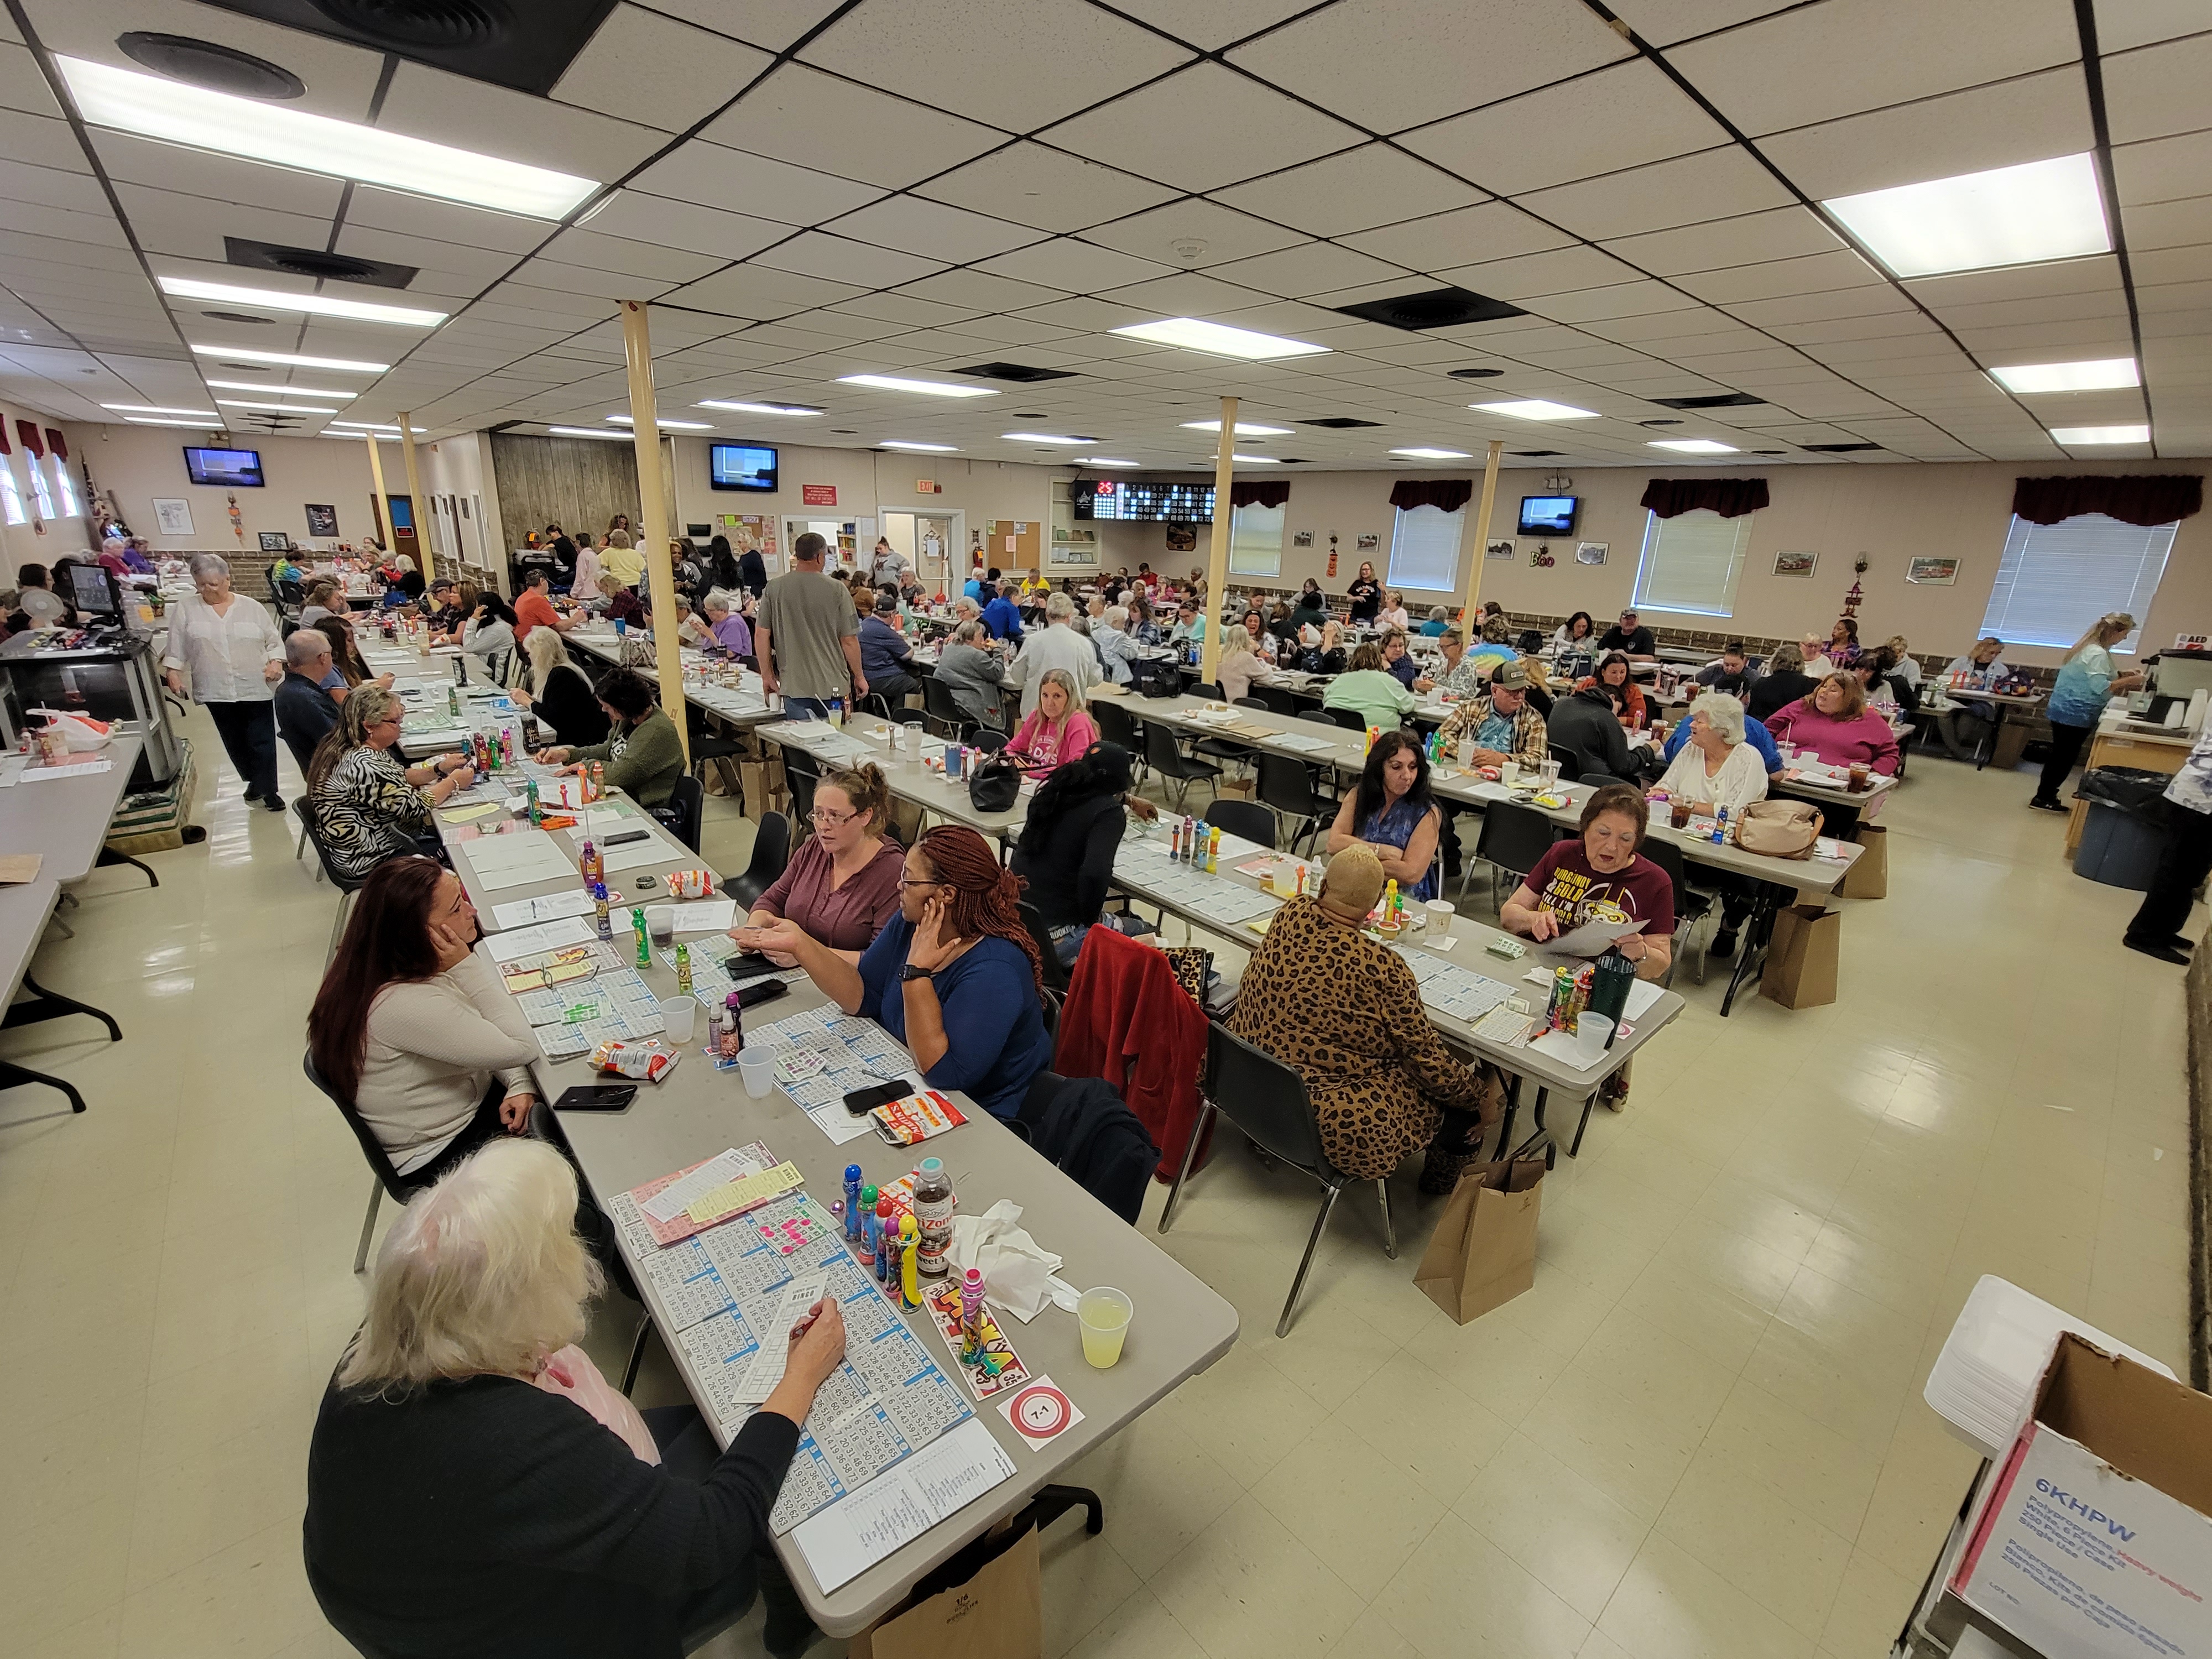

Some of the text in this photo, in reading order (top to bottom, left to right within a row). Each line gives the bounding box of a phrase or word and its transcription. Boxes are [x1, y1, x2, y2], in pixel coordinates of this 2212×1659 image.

[920, 481, 932, 491] EXIT
[1098, 481, 1113, 494] 25
[1546, 878, 1584, 902] & GOLD
[1553, 867, 1592, 890] BURGUNDY
[1542, 891, 1557, 906] TILL
[1558, 899, 1574, 912] I'M
[891, 1104, 921, 1135] MARTIN'S
[917, 1212, 953, 1230] riZon
[917, 1255, 938, 1264] weet
[792, 1290, 815, 1301] BINGO
[929, 1287, 943, 1298] 20
[994, 1340, 1005, 1353] 11
[983, 1352, 1015, 1376] 4
[1003, 1374, 1018, 1387] 35
[896, 1392, 932, 1436] 13 22 33 53 63
[911, 1395, 920, 1404] 21
[925, 1412, 934, 1421] 56
[931, 1420, 941, 1430] 70
[914, 1381, 950, 1424] 11 23 41 58 75
[928, 1384, 938, 1392] 16
[936, 1392, 945, 1401] 35
[942, 1401, 952, 1410] 54
[948, 1409, 958, 1418] 71
[953, 1397, 961, 1405] G
[1030, 1405, 1049, 1420] 7-1
[868, 1420, 878, 1428] 27
[876, 1431, 885, 1439] 42
[881, 1438, 891, 1448] 56
[888, 1448, 898, 1457] 65
[893, 1406, 902, 1415] 24
[900, 1416, 909, 1424] 43
[906, 1423, 916, 1432] 59
[912, 1432, 922, 1442] 72
[824, 1435, 858, 1482] 14 19 36 58 73
[839, 1438, 849, 1448] 20
[846, 1447, 855, 1457] 31
[853, 1458, 862, 1467] 48
[858, 1467, 868, 1476] 69
[849, 1432, 859, 1442] 18
[862, 1451, 872, 1460] 50
[868, 1459, 879, 1470] 74
[859, 1426, 869, 1436] 25
[865, 1436, 875, 1445] 34
[872, 1444, 881, 1454] 55
[878, 1454, 888, 1464] 61
[2029, 1494, 2115, 1553] Polypropylene,
[2036, 1478, 2137, 1542] 6KHPW
[2018, 1516, 2078, 1558] Single Use
[2022, 1509, 2042, 1525] 250
[2044, 1524, 2075, 1547] Piece
[2084, 1549, 2115, 1571] Case
[2063, 1526, 2071, 1535] 6
[2073, 1532, 2105, 1556] Piece
[2109, 1554, 2126, 1569] Kit
[1989, 1581, 2006, 1595] LOT
[2001, 1552, 2021, 1569] 250
[2022, 1567, 2059, 1595] Piezas
[2060, 1595, 2081, 1610] por
[2048, 1575, 2071, 1594] Kits
[2073, 1593, 2089, 1604] de
[2090, 1604, 2135, 1635] comida
[2089, 1593, 2104, 1605] de
[2106, 1605, 2137, 1625] peso
[2138, 1625, 2185, 1656] pesado
